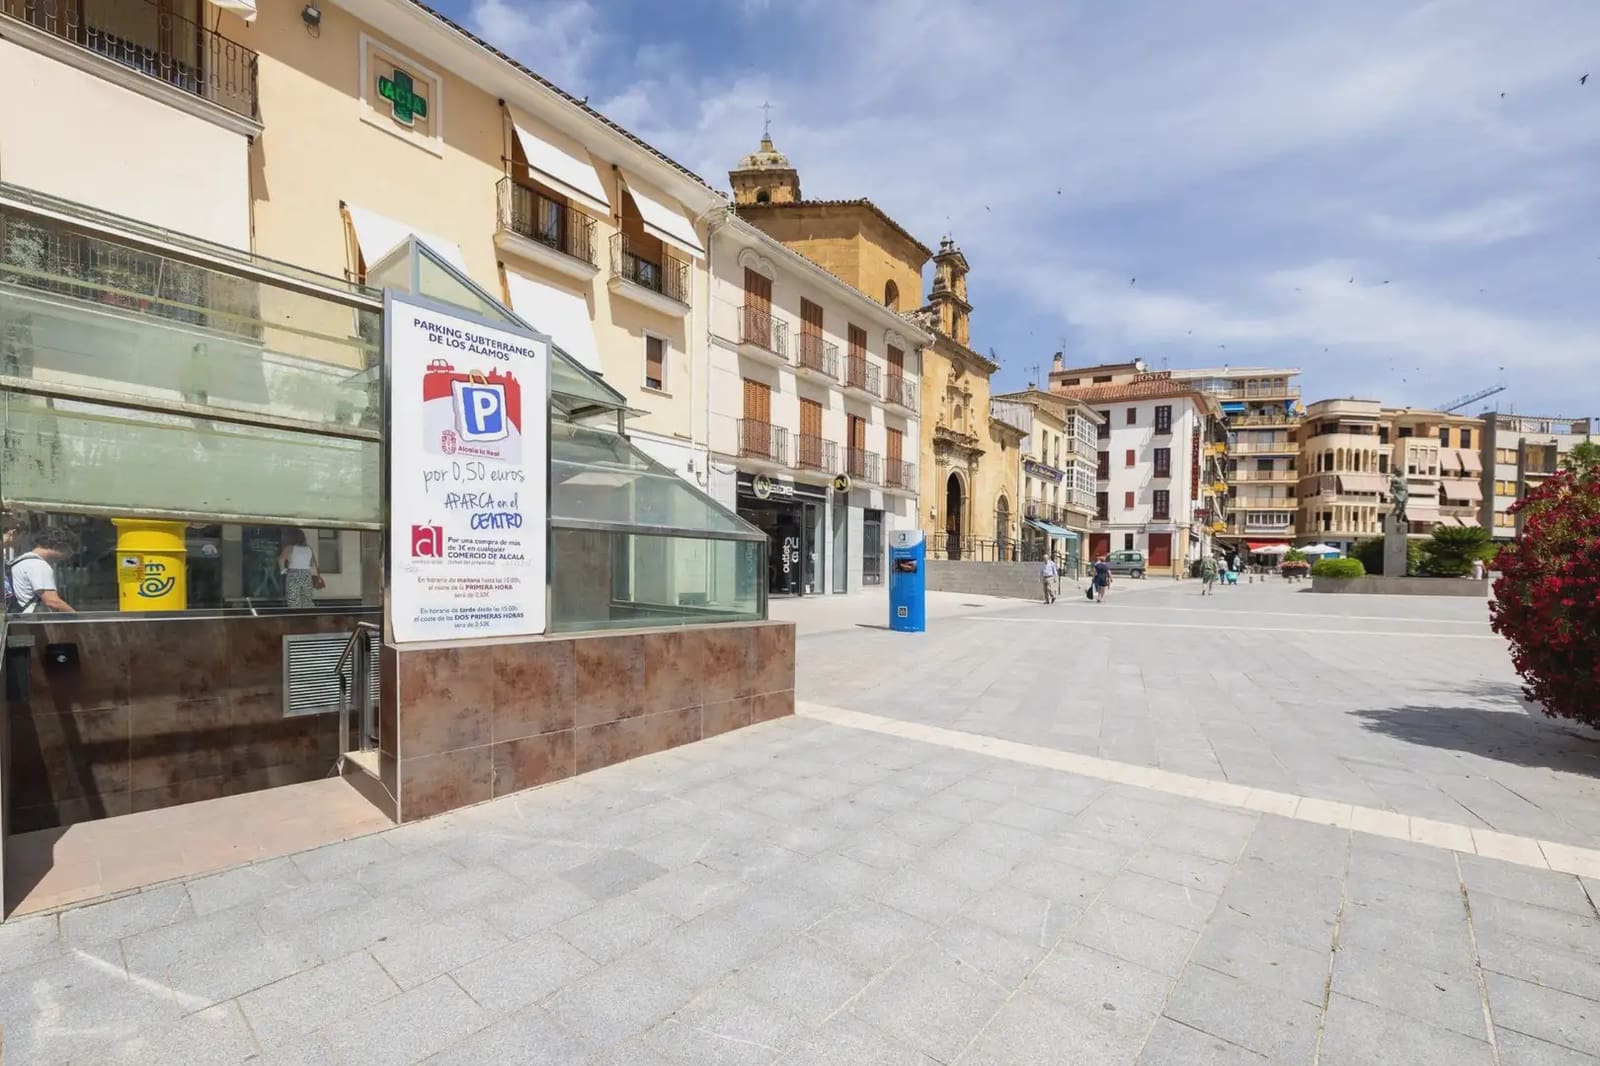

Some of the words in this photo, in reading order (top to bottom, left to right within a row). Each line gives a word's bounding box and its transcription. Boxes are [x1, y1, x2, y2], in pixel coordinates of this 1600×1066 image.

[414, 318, 462, 339] PARKING
[465, 332, 535, 358] SUBTERRANEO
[429, 334, 443, 344] DE
[446, 338, 466, 350] LOS
[469, 344, 510, 361] ALAMOS
[473, 391, 498, 432] P
[423, 470, 448, 494] por
[452, 462, 485, 484] 0,50
[490, 470, 525, 482] euros
[444, 492, 494, 510] APARCA
[510, 492, 518, 509] el
[471, 512, 522, 530] CENTRO
[782, 544, 790, 573] outlet
